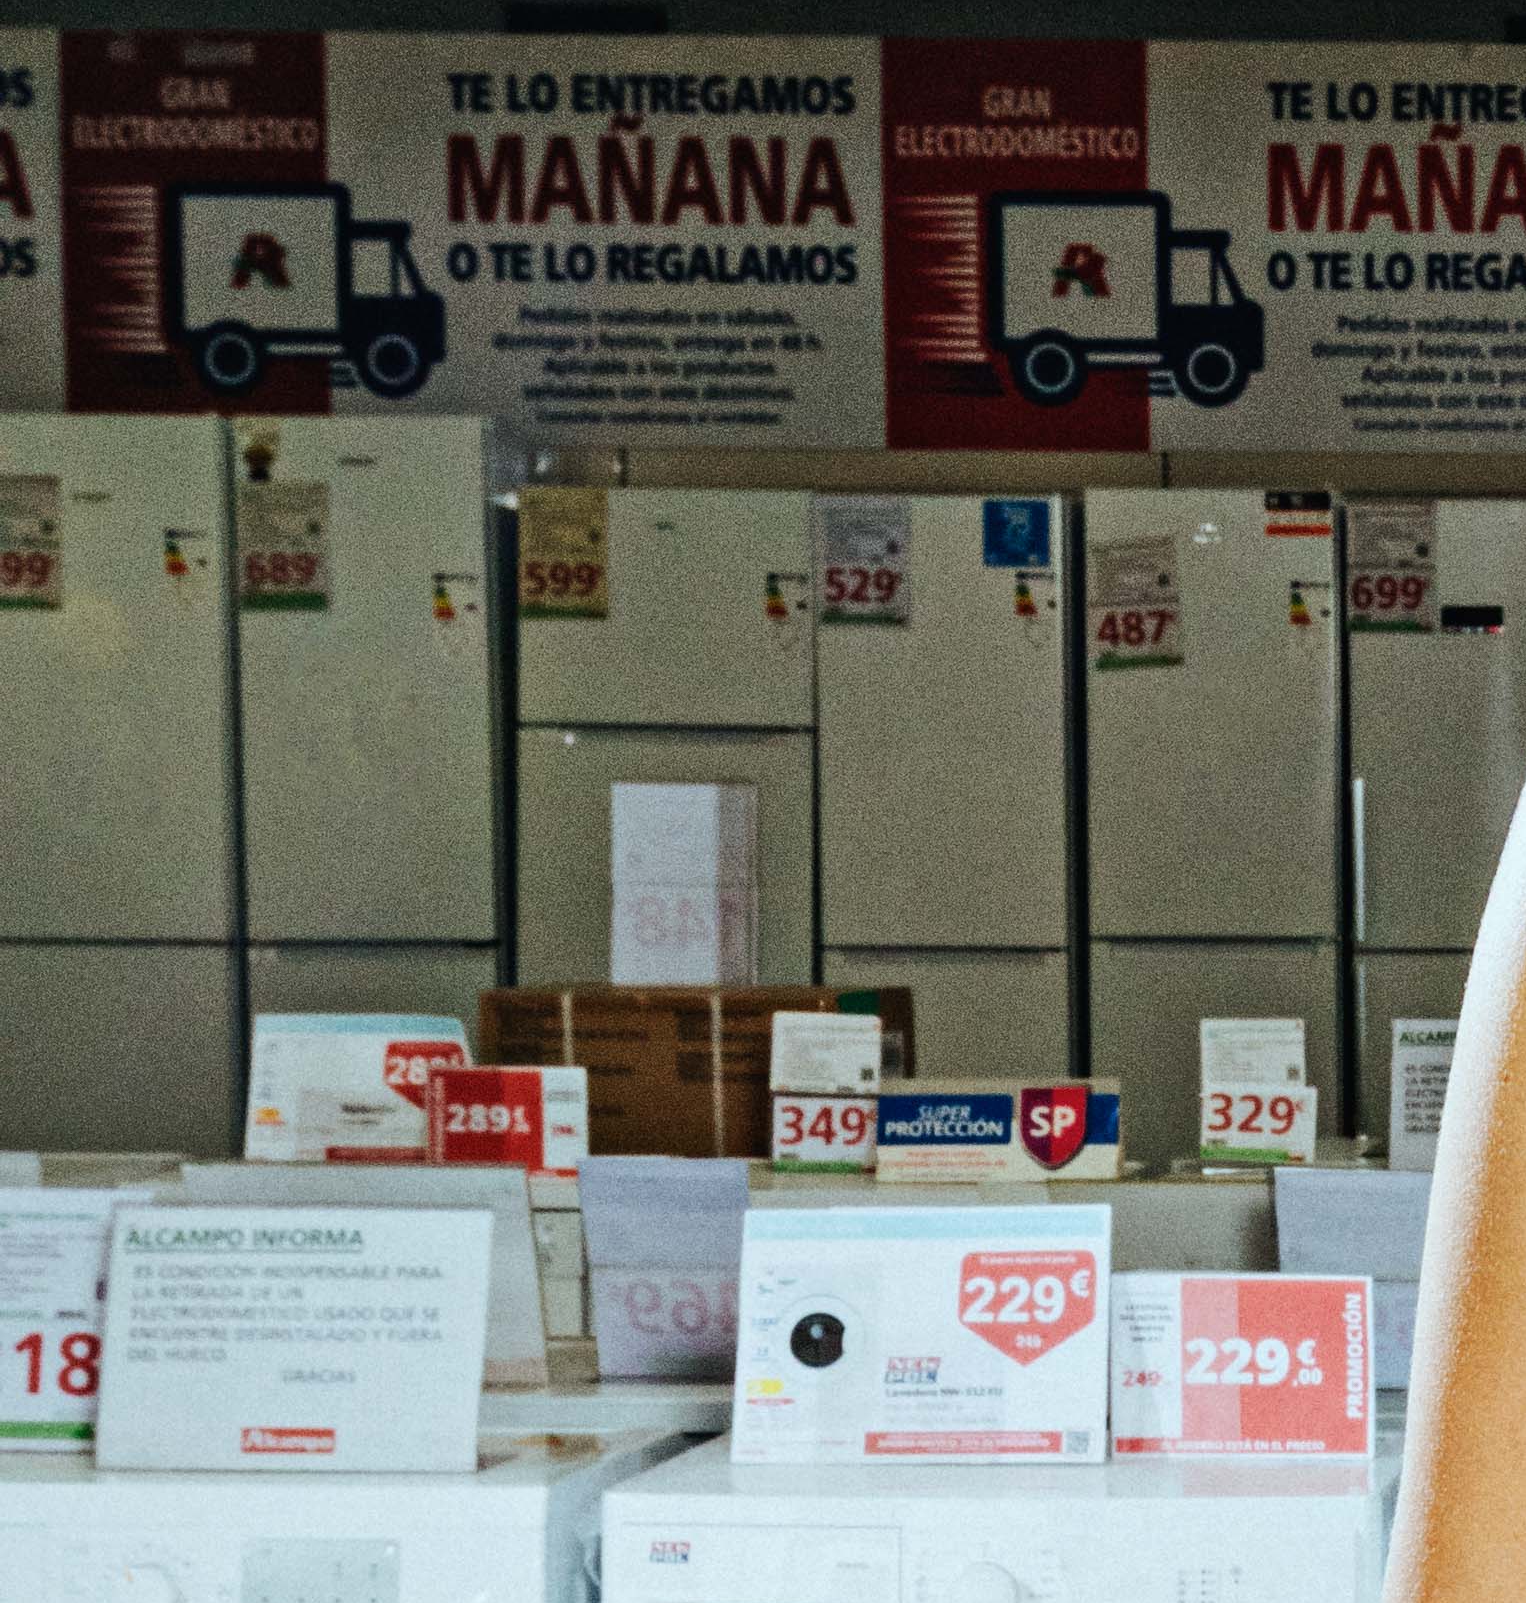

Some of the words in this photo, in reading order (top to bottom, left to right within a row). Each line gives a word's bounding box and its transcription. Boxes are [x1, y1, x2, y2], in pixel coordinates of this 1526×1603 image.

[448, 73, 495, 114] TE
[506, 73, 560, 114] LO
[572, 74, 857, 115] ENTREGAMOS
[983, 85, 1051, 120] GRAN
[1268, 81, 1315, 122] TE
[1325, 81, 1377, 124] LO
[895, 120, 1139, 162] ELECTRODOMÉSTICO
[447, 115, 857, 226] MAÑANA
[447, 245, 480, 283] O
[488, 245, 533, 283] TE
[544, 245, 598, 284] LO
[608, 245, 858, 285] REGALAMOS
[1267, 255, 1297, 293] O
[1308, 255, 1353, 293] TE
[1364, 255, 1414, 293] LO
[885, 1117, 1003, 1136] PROTECCIÓN
[1030, 1106, 1076, 1138] SP
[127, 1228, 244, 1246] ALCAMPO
[252, 1229, 362, 1246] INFORMA
[1342, 1293, 1364, 1419] PROMOCIÓN
